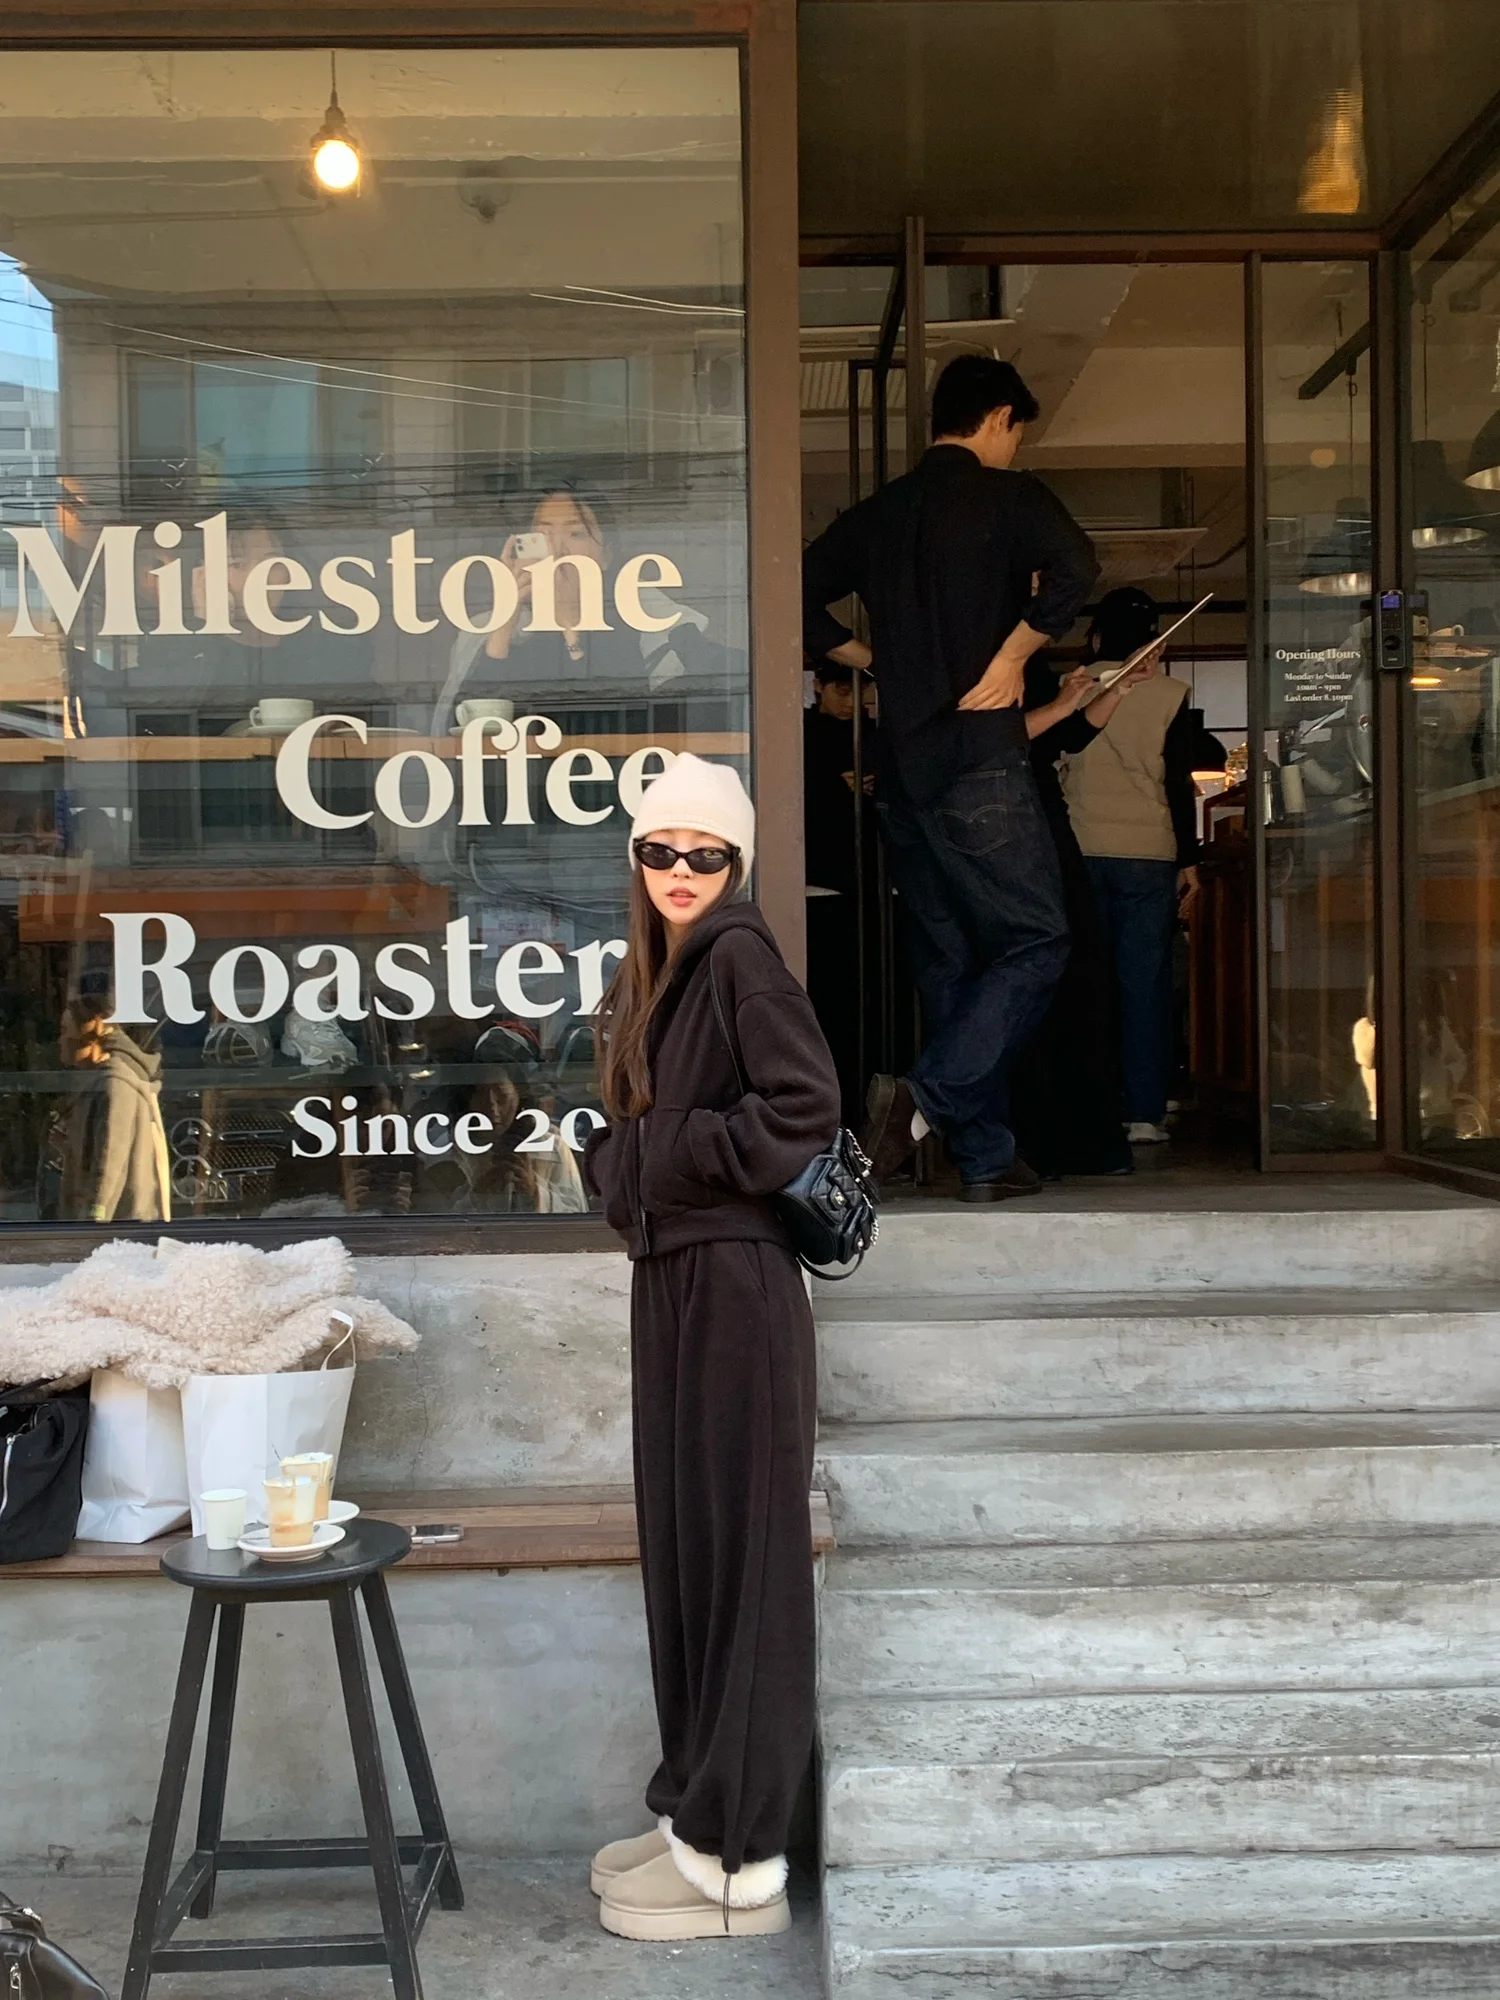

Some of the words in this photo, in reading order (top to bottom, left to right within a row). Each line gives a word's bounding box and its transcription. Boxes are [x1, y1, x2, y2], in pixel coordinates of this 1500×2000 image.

[3, 511, 683, 637] Milestone
[1275, 649, 1325, 662] Opening
[1326, 648, 1361, 660] Hours
[1284, 672, 1314, 682] Monday
[1325, 672, 1352, 682] Sunday
[1284, 694, 1301, 702] Last
[1302, 694, 1322, 702] order
[275, 714, 677, 829] Coffee
[99, 912, 629, 1025] Roaster
[291, 1096, 494, 1158] Since
